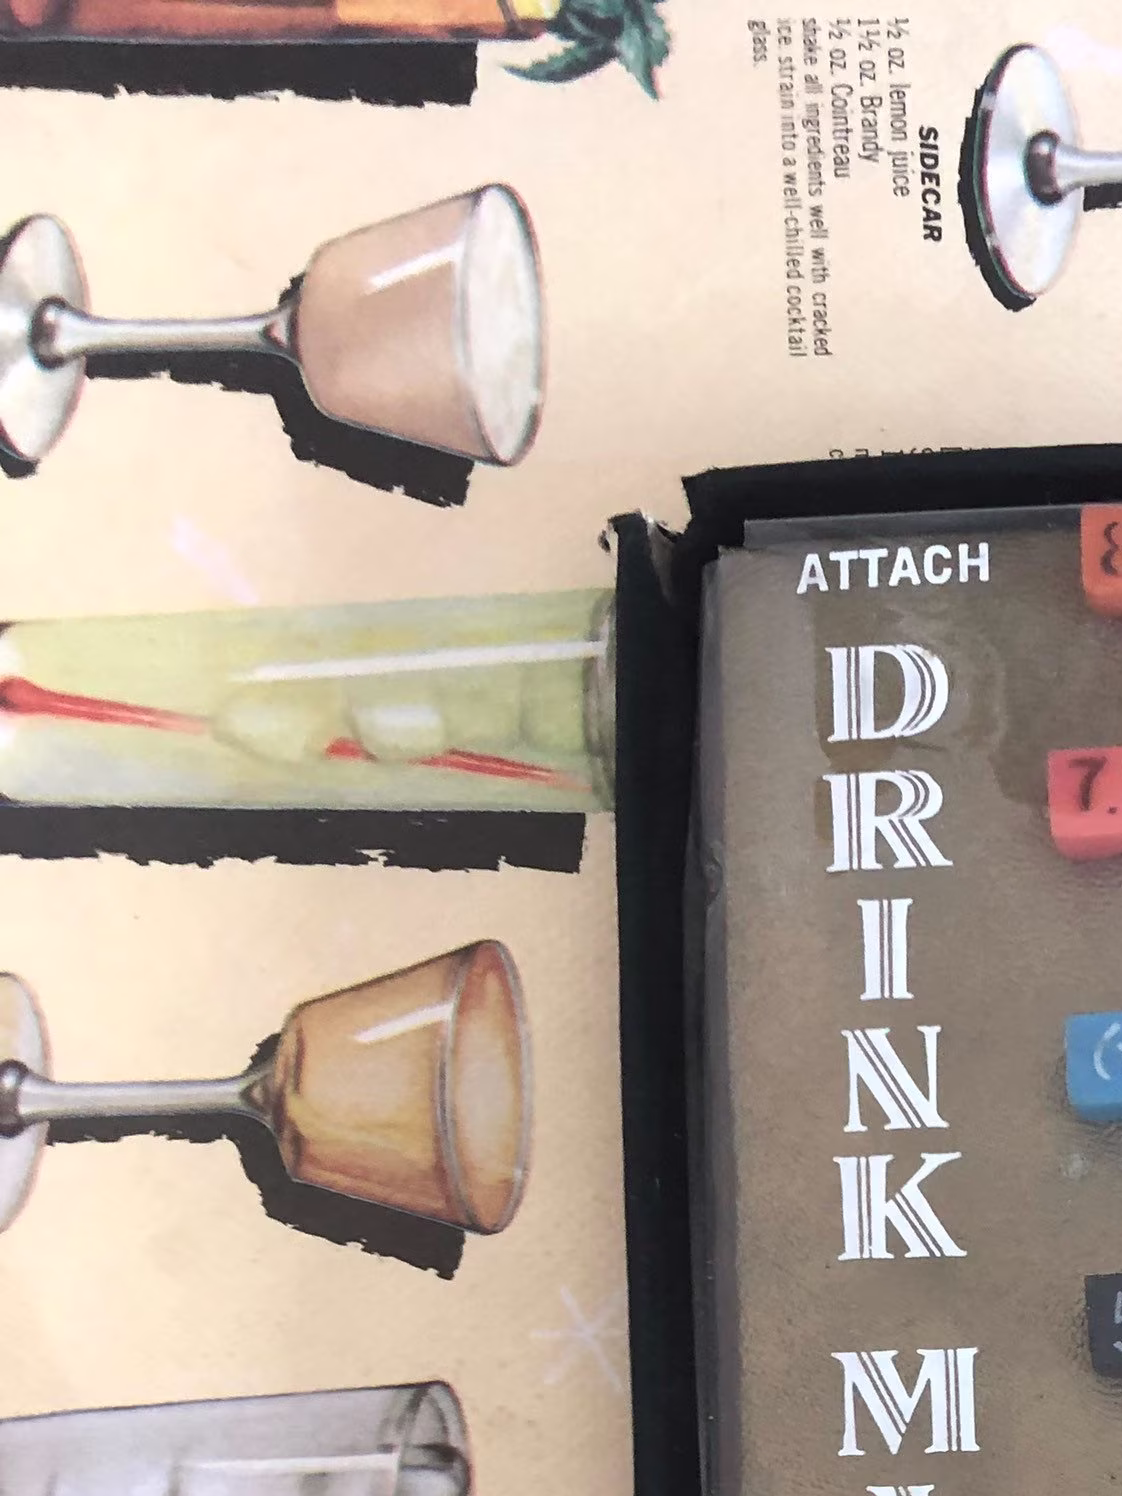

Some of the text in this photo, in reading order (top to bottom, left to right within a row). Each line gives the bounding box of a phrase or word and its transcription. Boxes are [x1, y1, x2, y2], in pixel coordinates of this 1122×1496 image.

[831, 84, 854, 178] Cointreau
[858, 95, 884, 163] Brandy
[887, 84, 912, 197] lemon juice
[918, 124, 942, 242] SIDECAR
[797, 542, 989, 594] ATTACH
[822, 644, 967, 1263] DRINK
